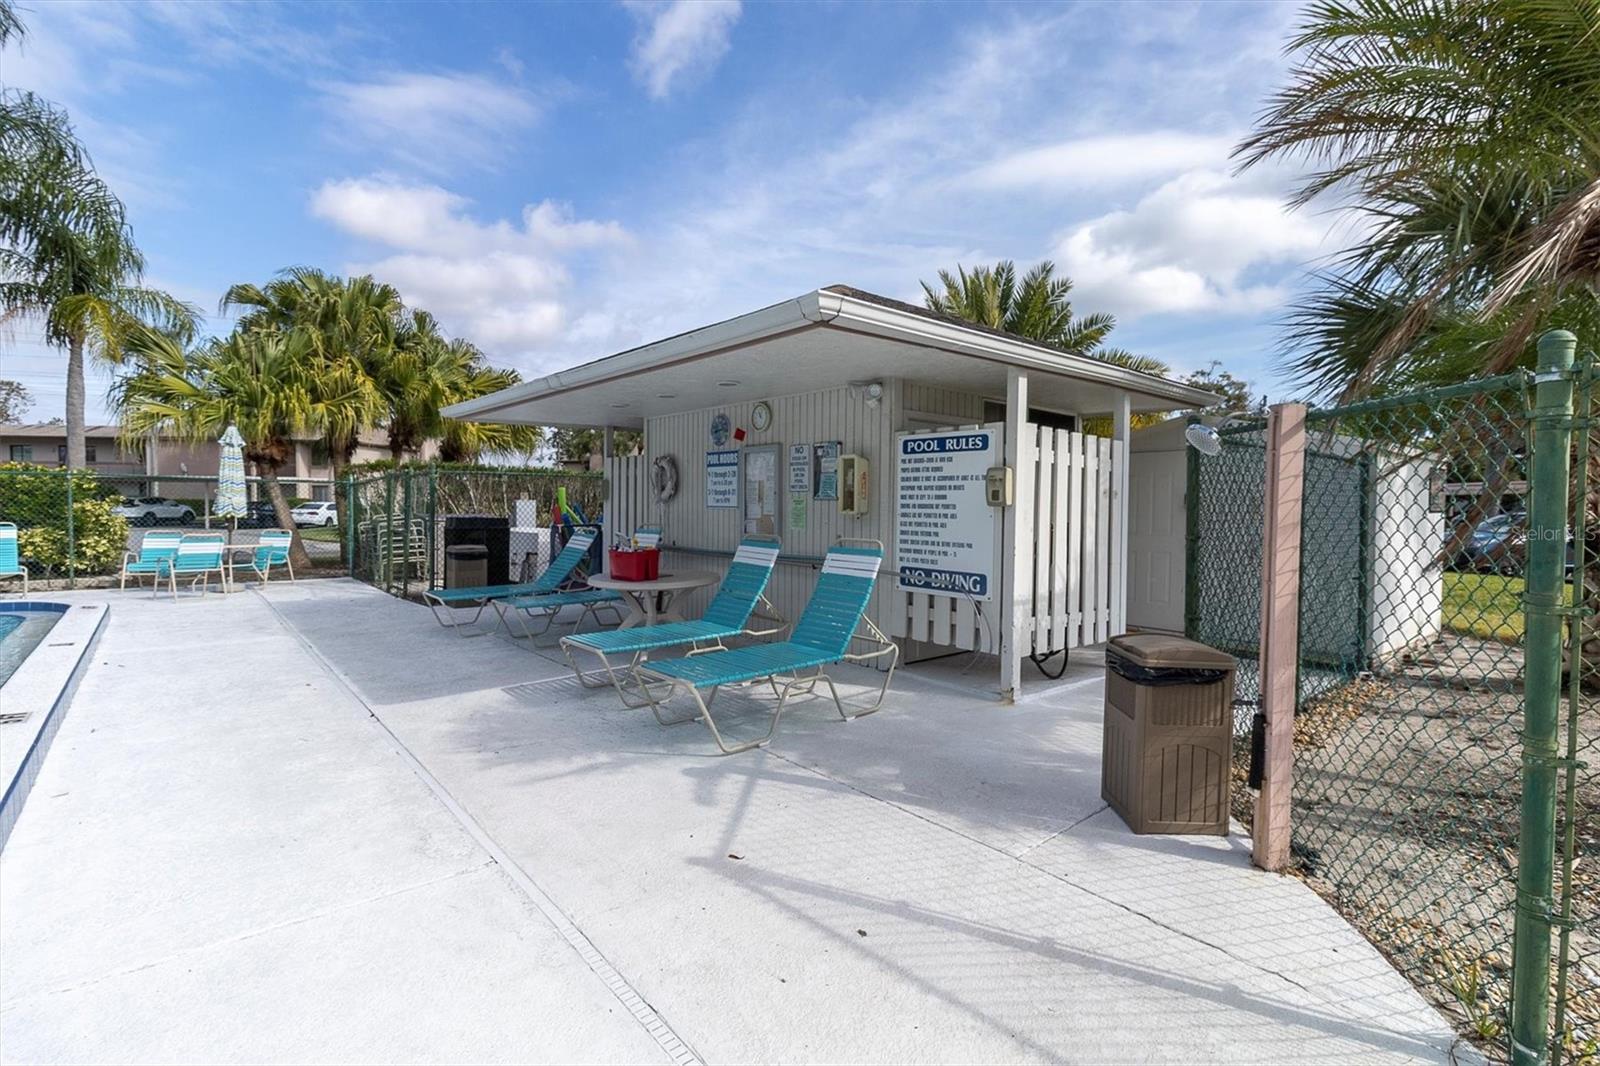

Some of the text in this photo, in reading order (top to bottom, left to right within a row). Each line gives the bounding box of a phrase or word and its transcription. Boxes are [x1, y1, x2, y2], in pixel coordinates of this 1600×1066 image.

[794, 446, 804, 454] NO
[907, 436, 983, 453] POOL RULES
[707, 454, 719, 465] POOL
[905, 568, 981, 593] NO DIVING
